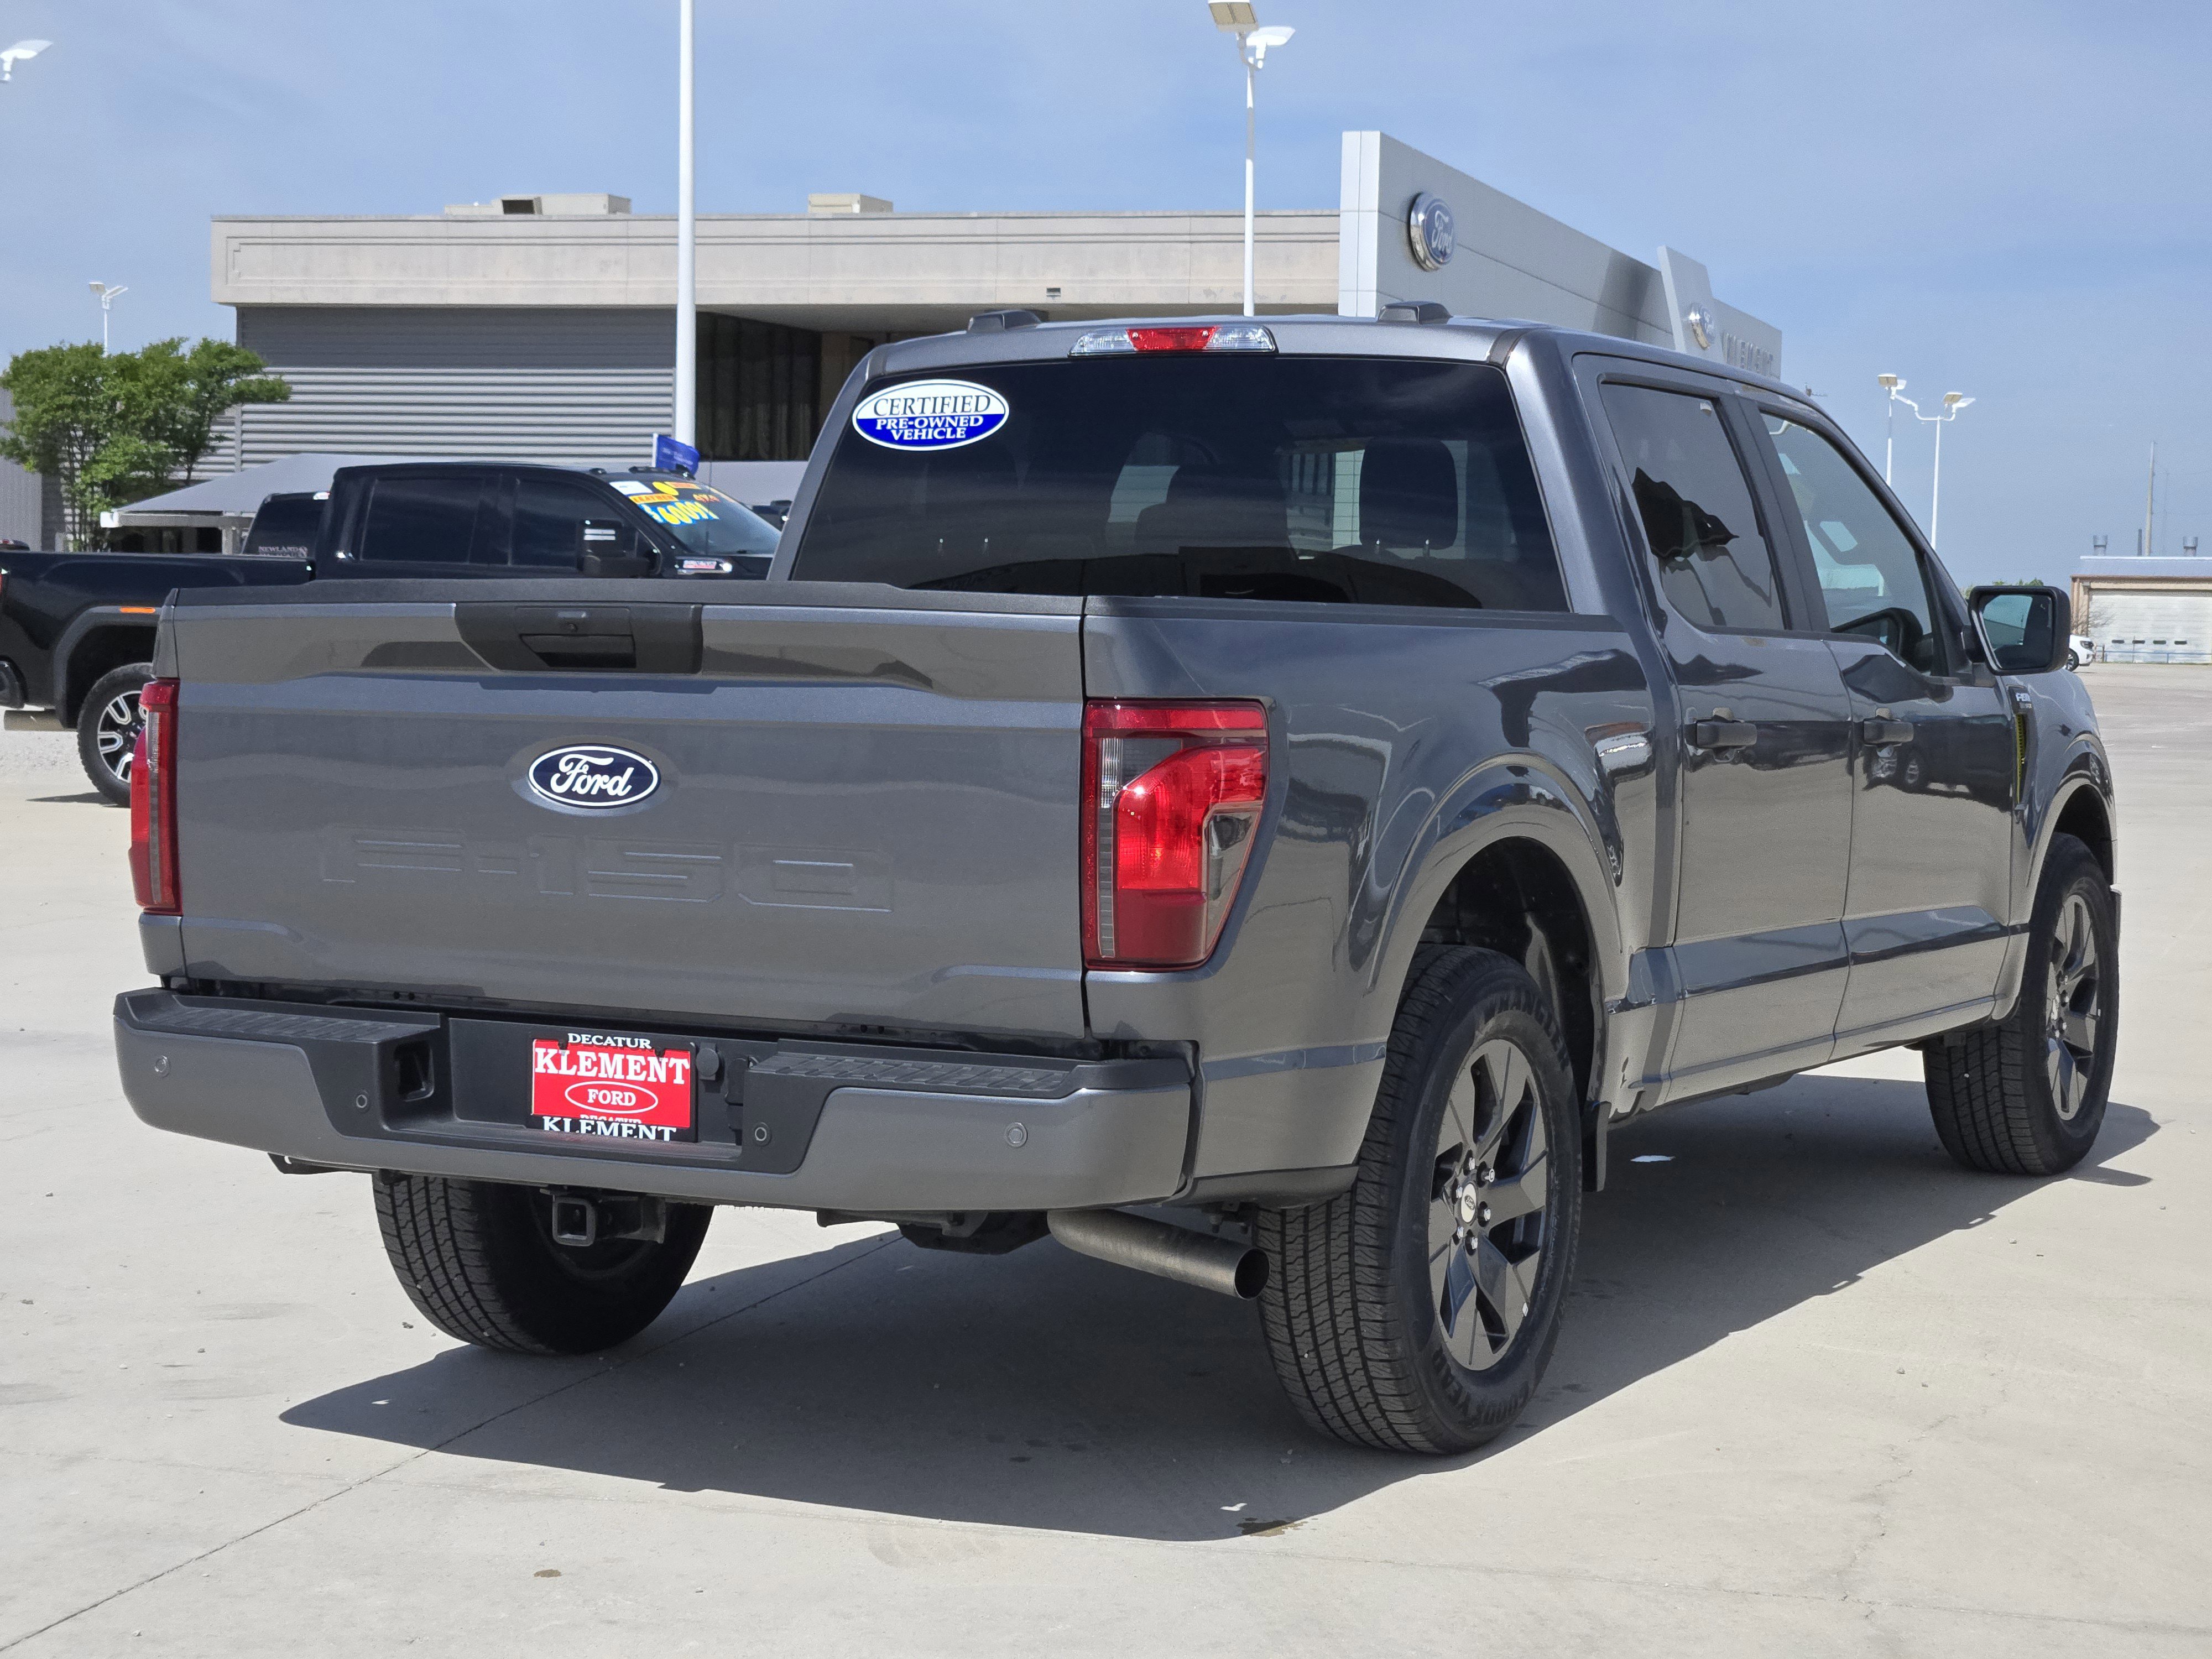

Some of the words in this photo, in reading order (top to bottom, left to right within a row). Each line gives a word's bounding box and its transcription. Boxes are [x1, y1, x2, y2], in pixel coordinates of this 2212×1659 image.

[1431, 211, 1453, 254] Ford
[874, 395, 990, 416] CERTIFIED
[876, 416, 983, 430] PRE-OWNED
[891, 427, 966, 440] VEHICLE
[550, 754, 635, 797] Ford
[321, 824, 894, 911] F-150
[568, 1033, 651, 1049] DECATUR
[534, 1047, 690, 1084] KLEMENT
[587, 1089, 636, 1107] FORD
[542, 1116, 677, 1141] KLEMENT
